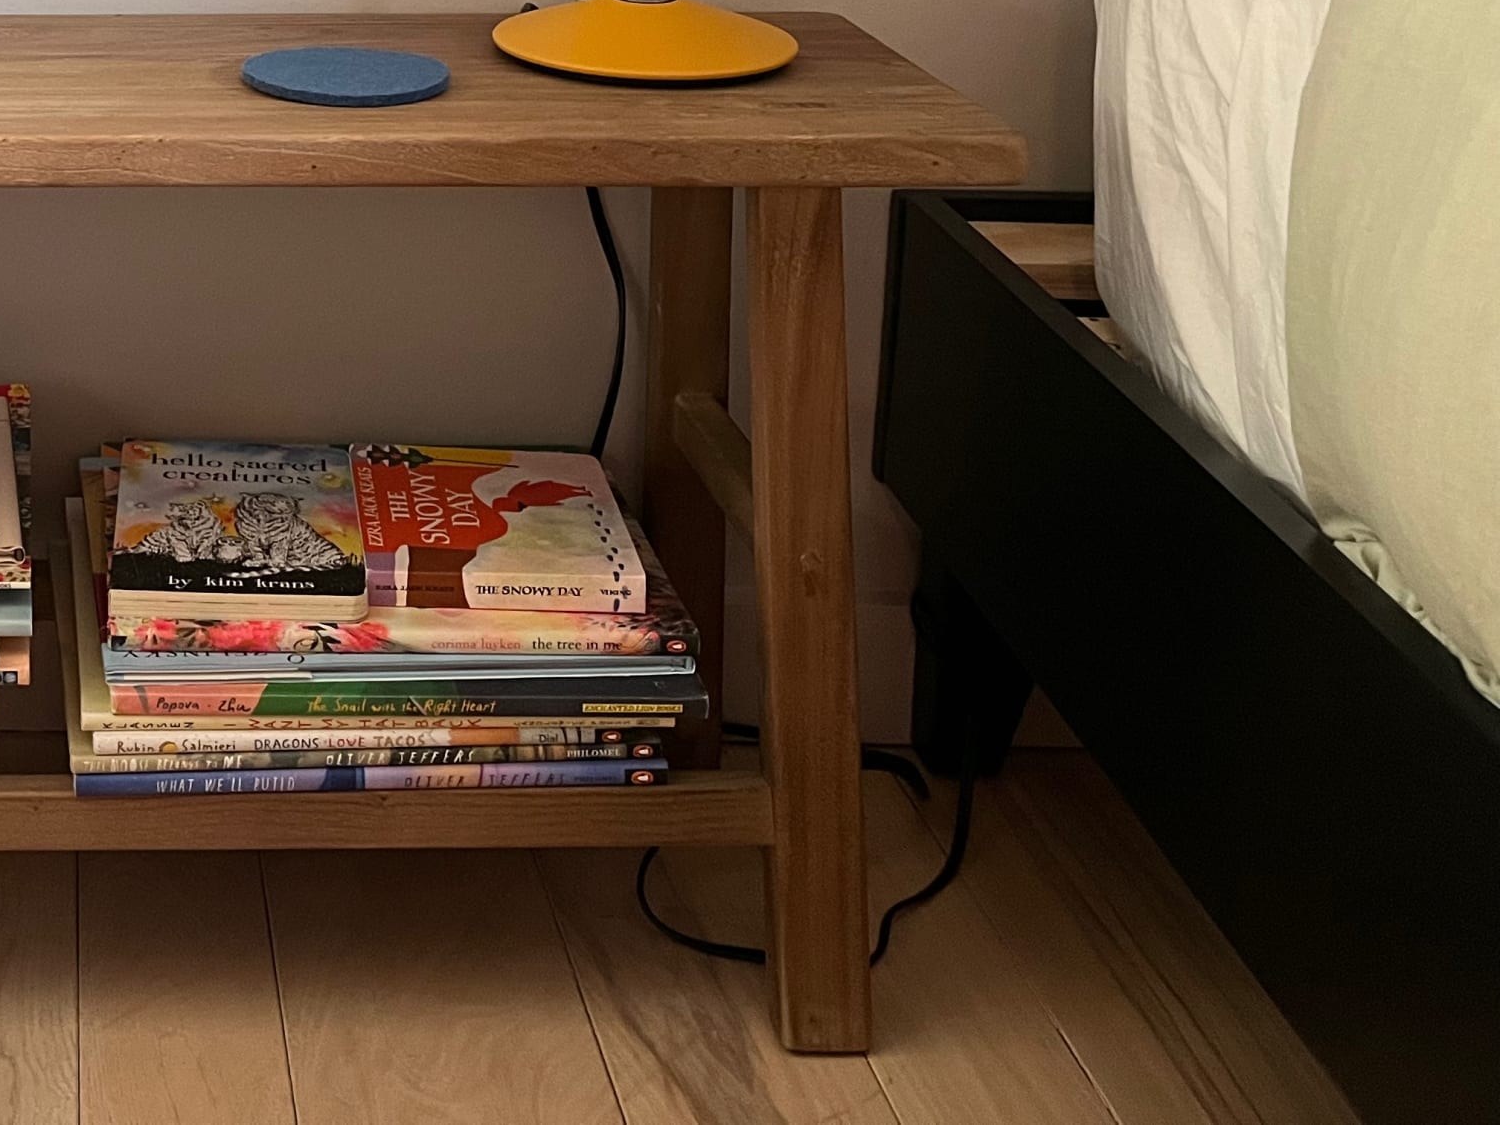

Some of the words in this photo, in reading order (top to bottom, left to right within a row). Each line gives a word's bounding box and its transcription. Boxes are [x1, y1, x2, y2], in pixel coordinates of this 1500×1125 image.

[151, 453, 223, 468] hello
[232, 458, 327, 472] sacred
[162, 468, 311, 484] creatures
[357, 467, 376, 494] KEATS
[362, 495, 380, 521] JACK
[387, 490, 412, 522] THE
[407, 470, 451, 545] SNOWY
[445, 488, 480, 528] DAY
[366, 521, 384, 547] EZRA
[167, 575, 192, 589] by
[205, 576, 244, 587] kim
[256, 578, 316, 589] krans
[475, 585, 500, 595] THE
[501, 586, 556, 596] SNOWY
[557, 586, 584, 597] DAY
[600, 588, 632, 596] VIKING
[431, 639, 477, 650] corinna
[480, 638, 521, 653] luyken
[532, 638, 553, 650] the
[556, 639, 582, 650] tree
[586, 639, 599, 650] in
[602, 641, 622, 651] me
[156, 697, 200, 713] Popova
[217, 700, 251, 713] Zhu
[333, 697, 367, 713] Snail
[371, 702, 395, 712] with
[423, 698, 457, 716] Right
[460, 698, 497, 713] Heart
[102, 721, 195, 730] KLASSEN
[249, 718, 312, 730] WANT
[322, 718, 349, 730] MY
[358, 718, 406, 729] HAT
[415, 718, 482, 729] BACK
[116, 741, 155, 753] Rubin
[181, 738, 237, 752] Salmieri
[254, 737, 321, 751] DRAGONS
[327, 736, 367, 749] LOVE
[373, 734, 427, 748] TACOS
[538, 733, 560, 743] Dial
[325, 751, 388, 766] OLIVER
[397, 749, 475, 764] JEFFERS
[566, 748, 621, 758] PHILOMEL
[222, 754, 243, 769] ME
[155, 778, 195, 794] WHAT
[204, 776, 244, 793] WE'LL
[404, 774, 466, 788] OLIVER
[487, 772, 565, 788] JEFFERS
